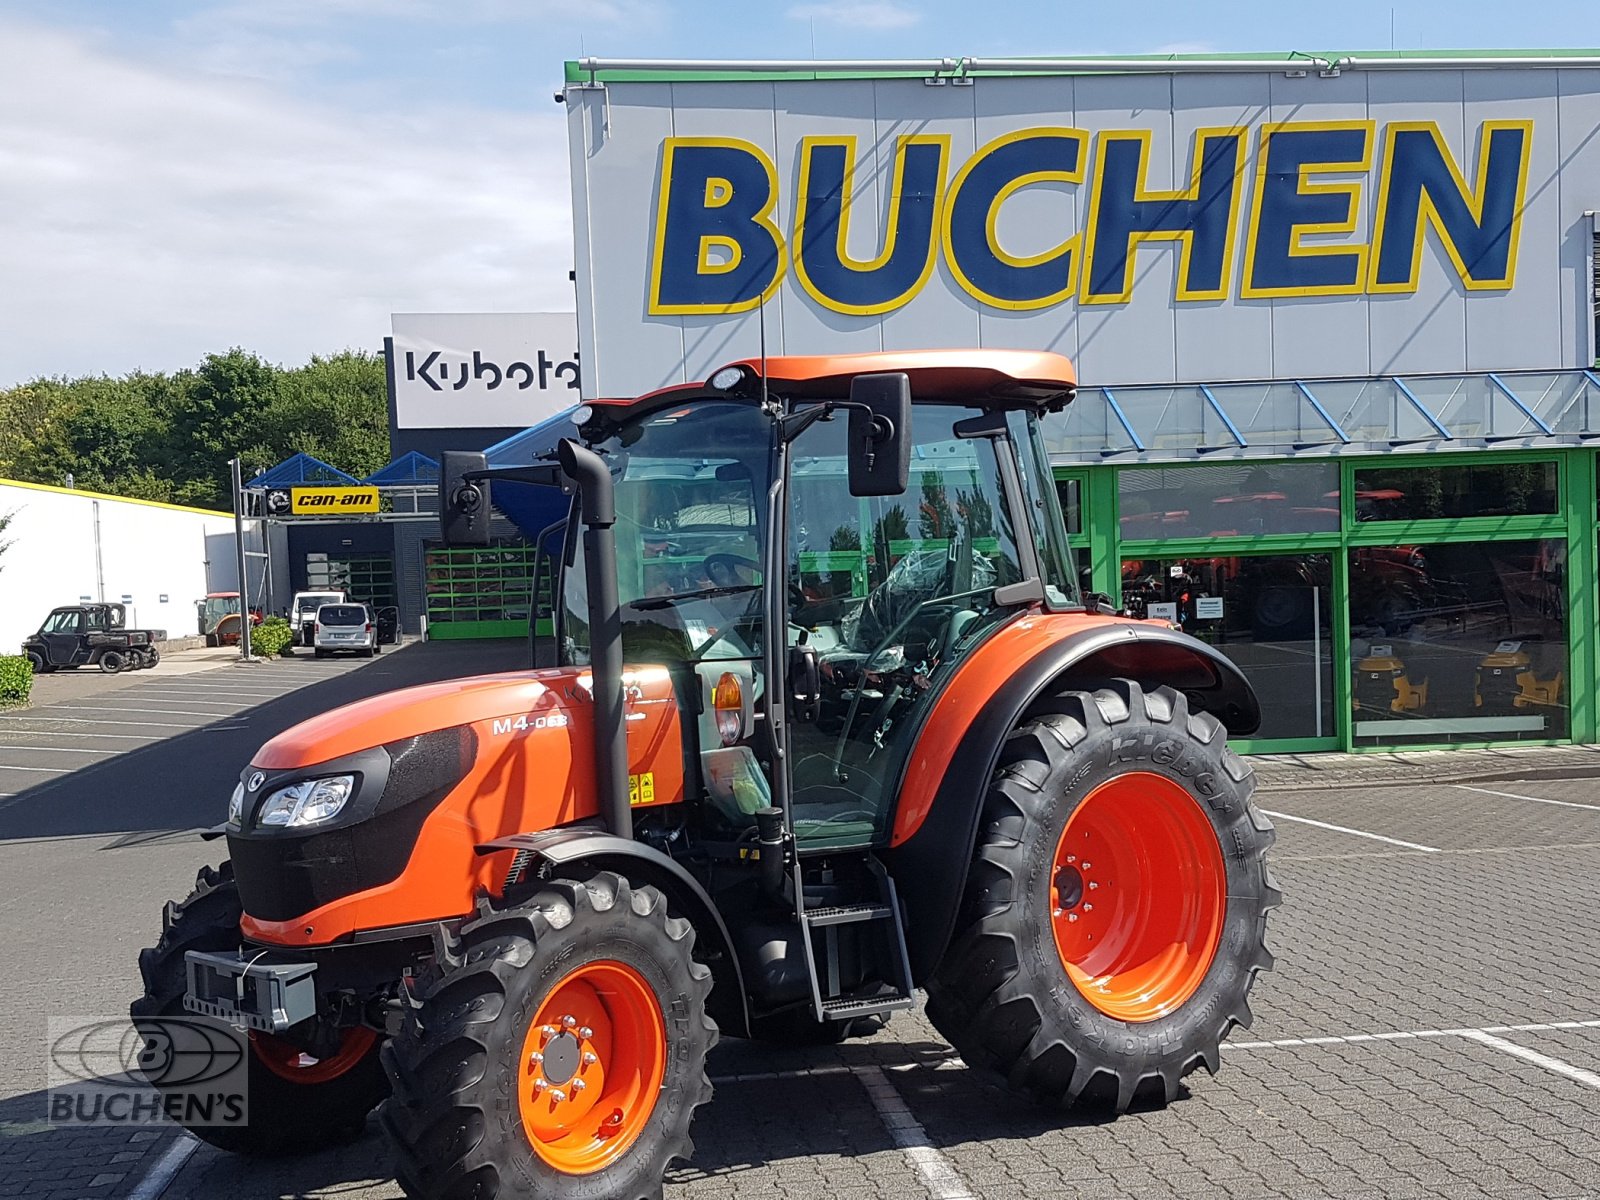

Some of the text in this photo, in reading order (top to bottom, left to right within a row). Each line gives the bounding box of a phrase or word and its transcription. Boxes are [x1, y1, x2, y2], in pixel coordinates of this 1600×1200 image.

[648, 120, 1533, 315] BUCHEN
[406, 350, 580, 391] Kubota
[297, 494, 373, 506] can-am
